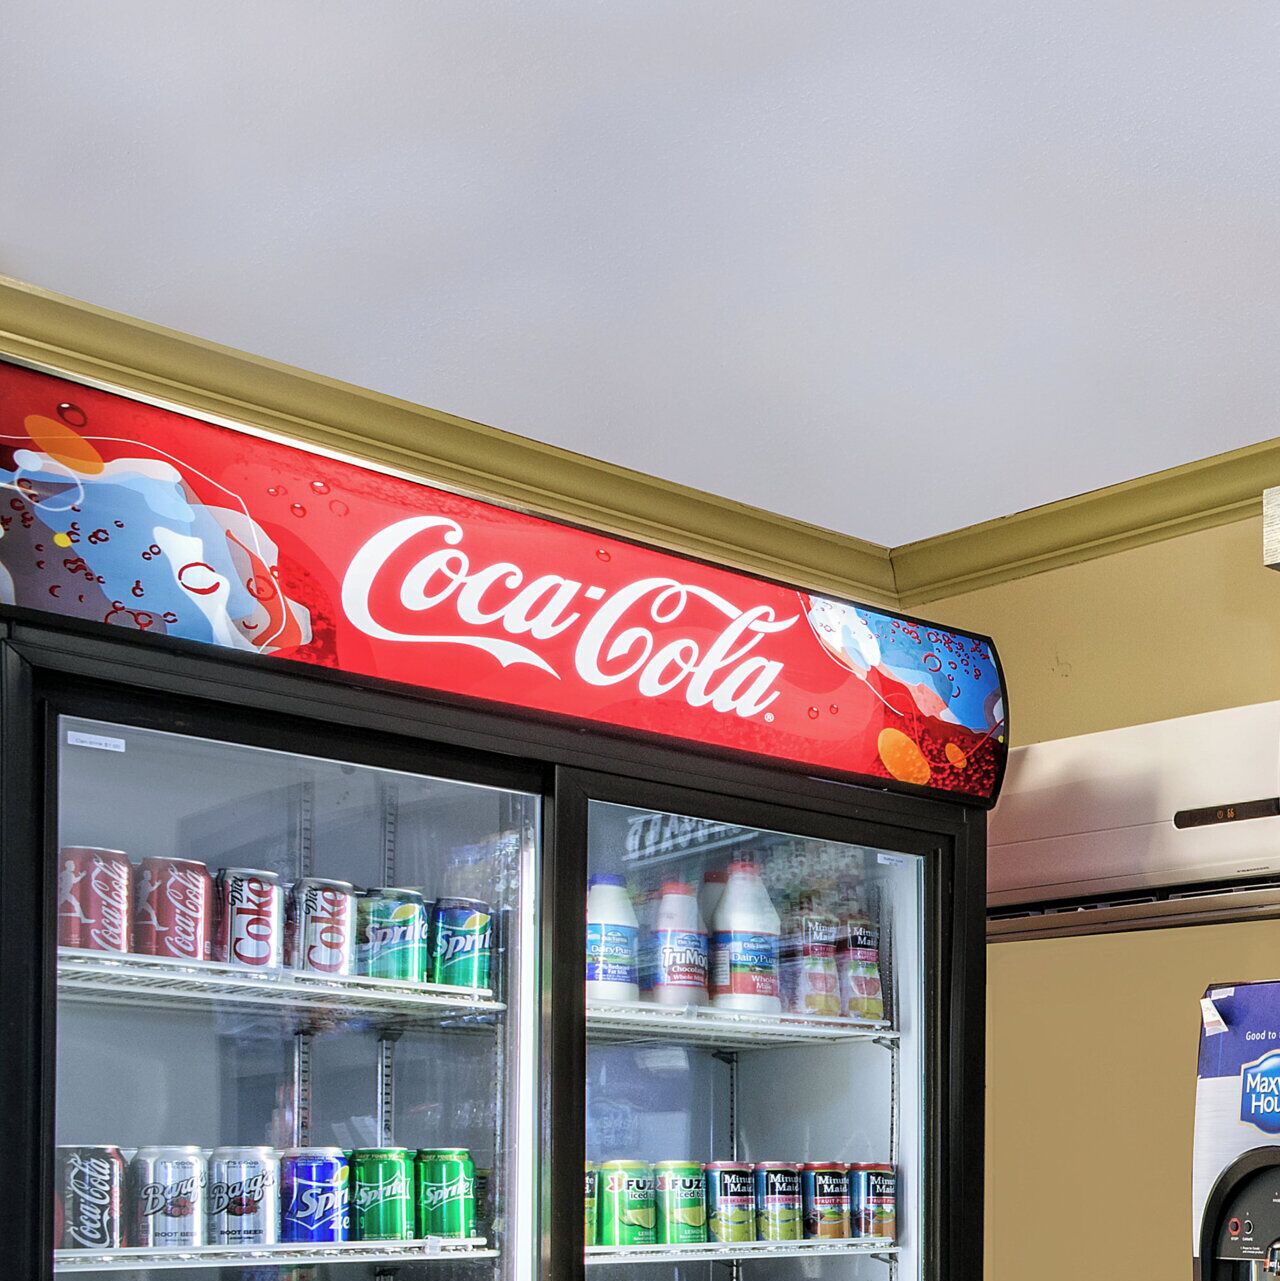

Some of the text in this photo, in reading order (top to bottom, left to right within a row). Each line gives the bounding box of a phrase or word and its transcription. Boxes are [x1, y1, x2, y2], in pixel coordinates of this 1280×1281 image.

[341, 515, 799, 719] Coca-Cola
[229, 876, 244, 906] Diet
[234, 877, 273, 965] Coke
[1246, 1030, 1266, 1040] Good
[1268, 1031, 1276, 1039] to
[211, 1170, 275, 1214] Barq's
